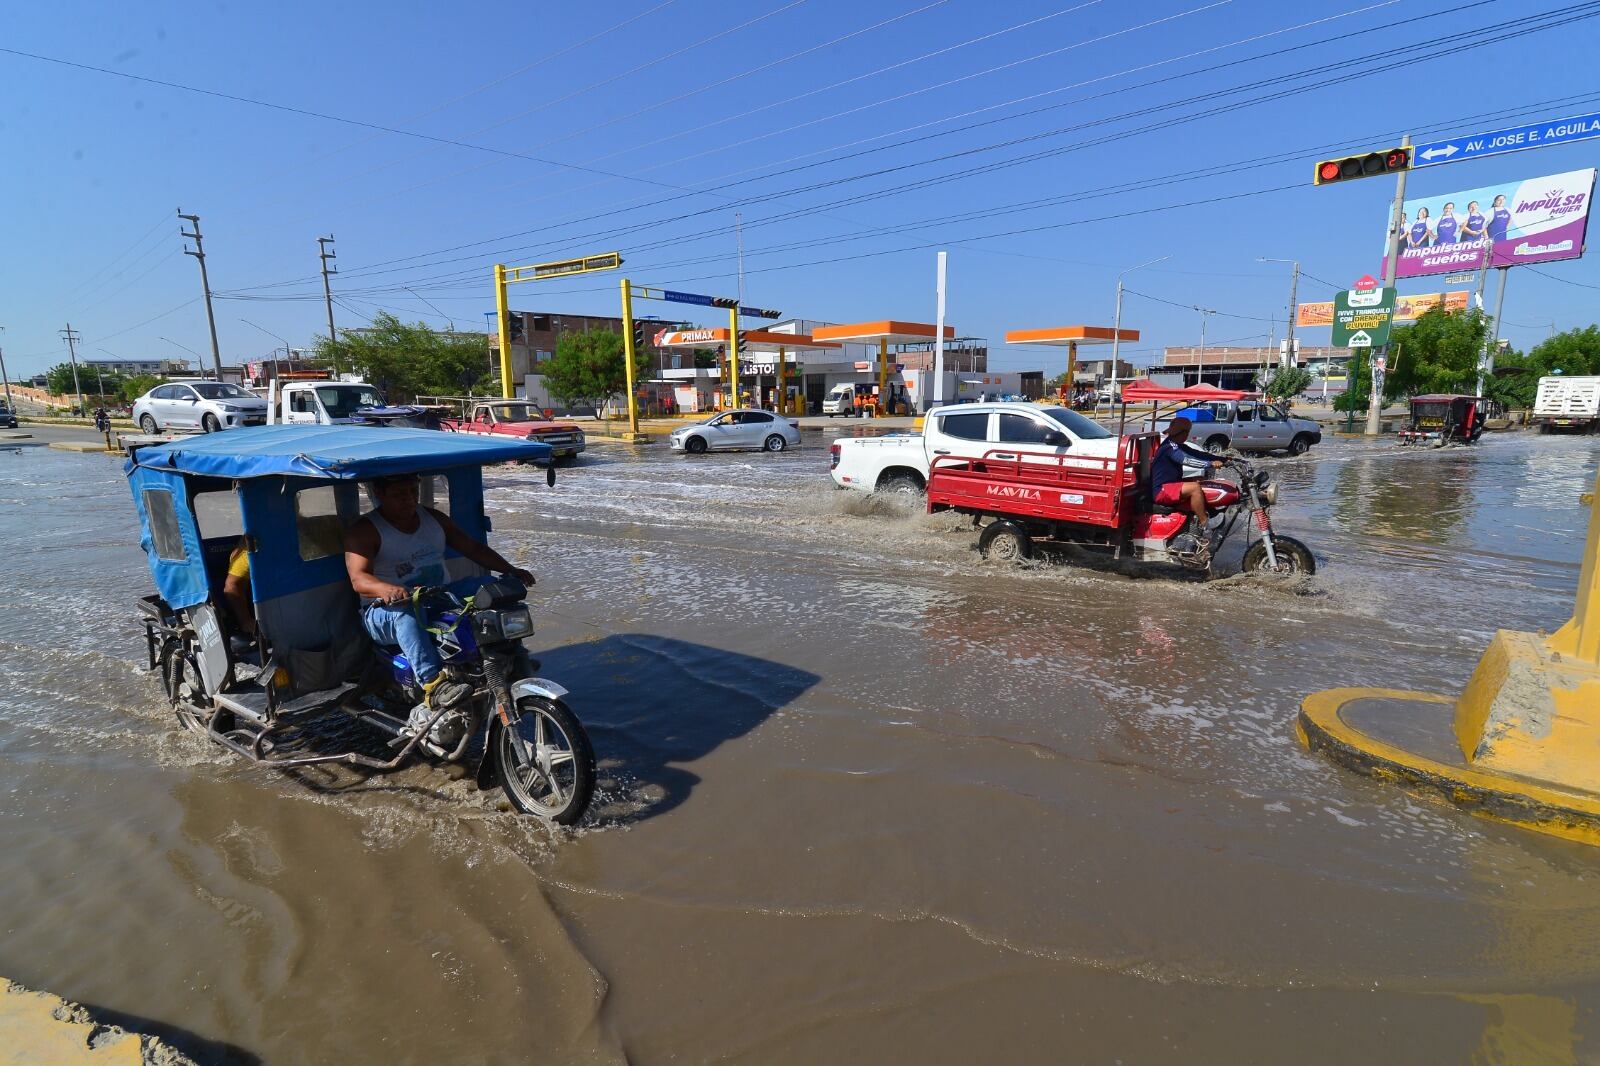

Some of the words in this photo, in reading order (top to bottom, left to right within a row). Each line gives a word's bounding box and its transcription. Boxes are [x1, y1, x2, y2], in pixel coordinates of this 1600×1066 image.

[1465, 140, 1485, 153] AV.
[1488, 132, 1525, 149] JOSE
[1528, 130, 1542, 142] E.
[1544, 119, 1600, 139] AGUILA
[1389, 153, 1405, 167] 27
[1549, 204, 1582, 215] MUJER
[1402, 237, 1493, 258] Impulsando
[1423, 250, 1477, 266] sueños
[1354, 313, 1388, 322] DRENAJE
[1355, 307, 1391, 316] TRANQUILO
[681, 330, 715, 343] PRIMAX
[986, 484, 1042, 501] MAVILA
